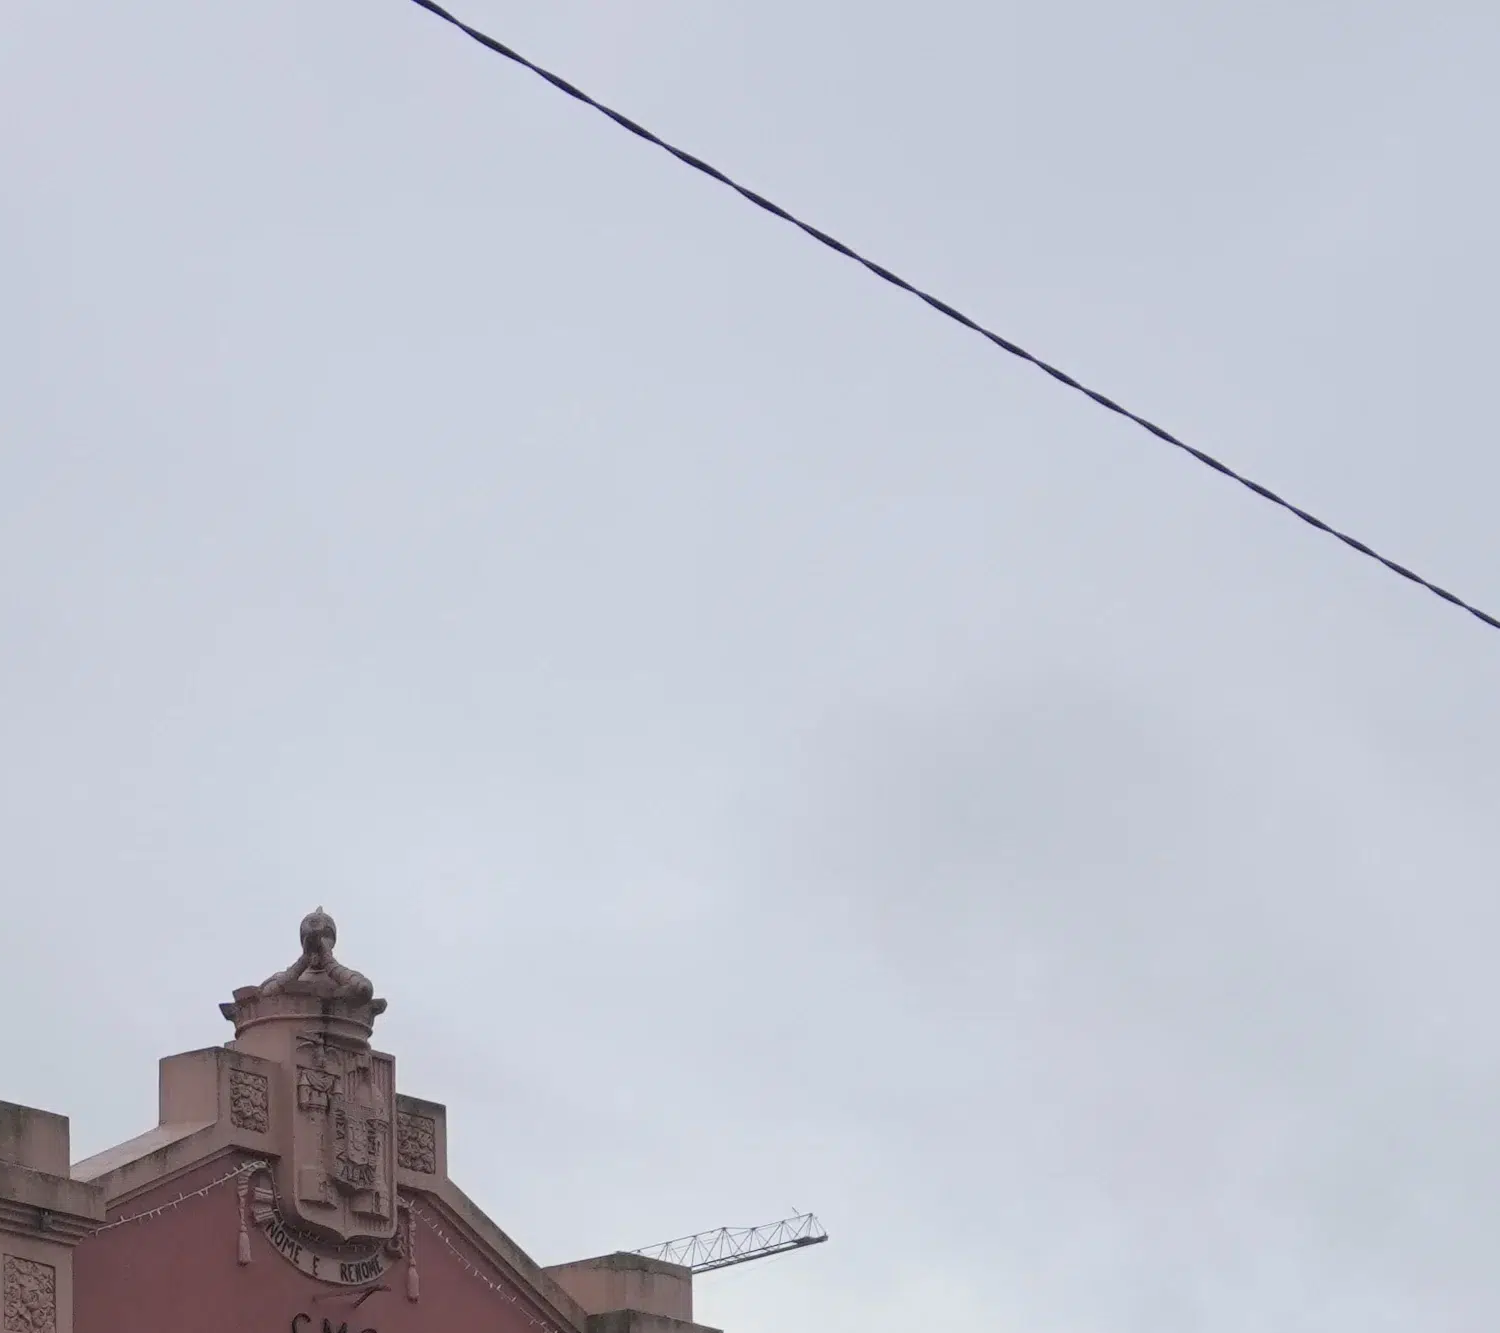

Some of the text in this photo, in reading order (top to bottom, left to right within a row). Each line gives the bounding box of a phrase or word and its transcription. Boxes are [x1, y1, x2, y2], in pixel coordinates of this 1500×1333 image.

[267, 1223, 384, 1282] NOME E RENOME
